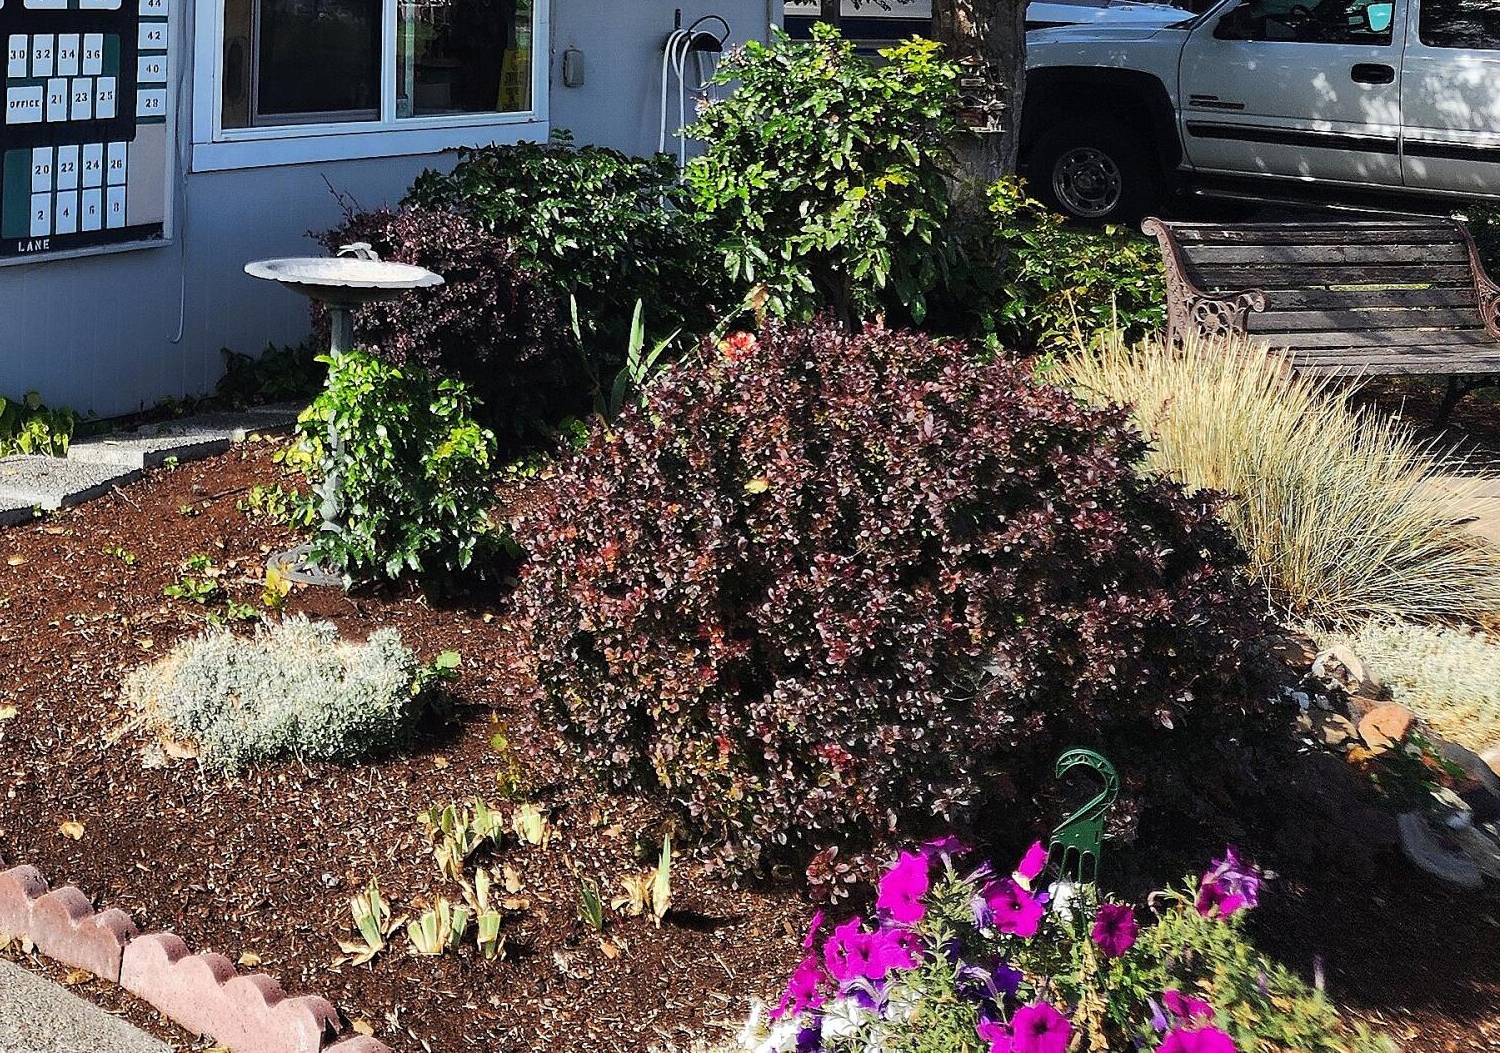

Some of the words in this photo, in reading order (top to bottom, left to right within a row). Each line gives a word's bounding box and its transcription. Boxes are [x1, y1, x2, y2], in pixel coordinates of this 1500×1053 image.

[147, 30, 161, 41] 42
[10, 49, 26, 60] 30
[35, 49, 51, 60] 32
[61, 49, 75, 60] 34
[86, 49, 101, 60] 36
[51, 94, 62, 105] 21
[74, 92, 88, 103] 23
[99, 90, 113, 101] 25
[9, 99, 40, 109] OFFICE
[60, 161, 74, 173] 22
[85, 159, 100, 171] 24
[110, 158, 123, 170] 26
[34, 164, 50, 176] 20
[62, 207, 69, 218] 4
[113, 201, 120, 213] 8
[37, 210, 44, 221] 2
[18, 238, 50, 252] LANE
